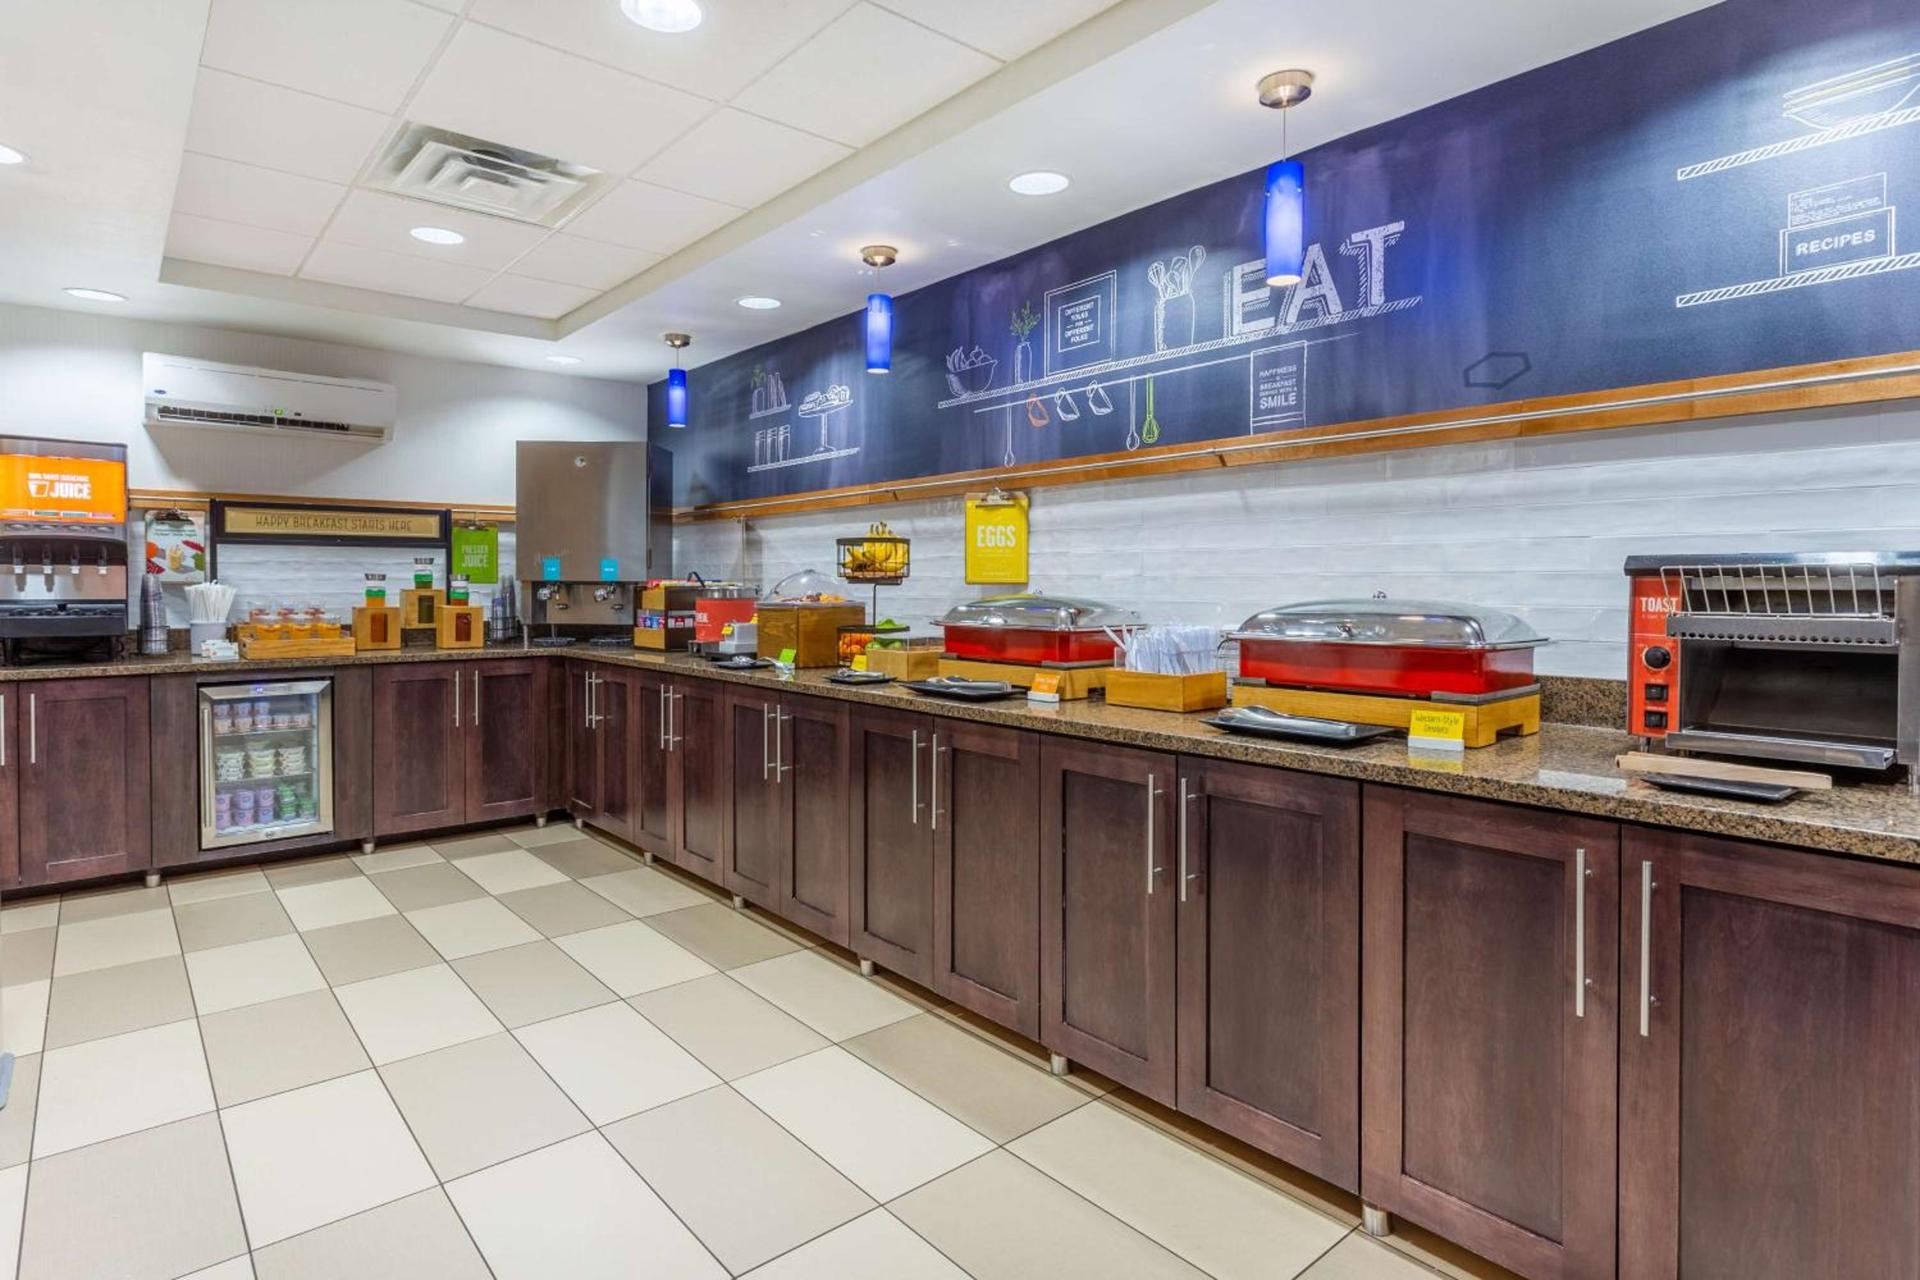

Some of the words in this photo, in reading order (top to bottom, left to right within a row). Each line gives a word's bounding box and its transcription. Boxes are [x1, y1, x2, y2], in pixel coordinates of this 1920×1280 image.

[1795, 229, 1876, 256] RECIPES
[1224, 220, 1405, 338] EAT
[1064, 301, 1094, 316] DIFFERENT
[1064, 323, 1094, 338] DIFFERENT
[1260, 378, 1297, 391] BREAKFAST
[1260, 392, 1297, 410] SMILE
[50, 481, 92, 500] JUICE
[255, 514, 289, 528] HAPPY
[292, 516, 349, 530] BREAKFAST
[351, 518, 385, 532] STARTS
[388, 519, 412, 532] HERE
[976, 525, 1016, 548] EGGS
[461, 553, 489, 568] JUICE
[1640, 597, 1678, 612] TOAST
